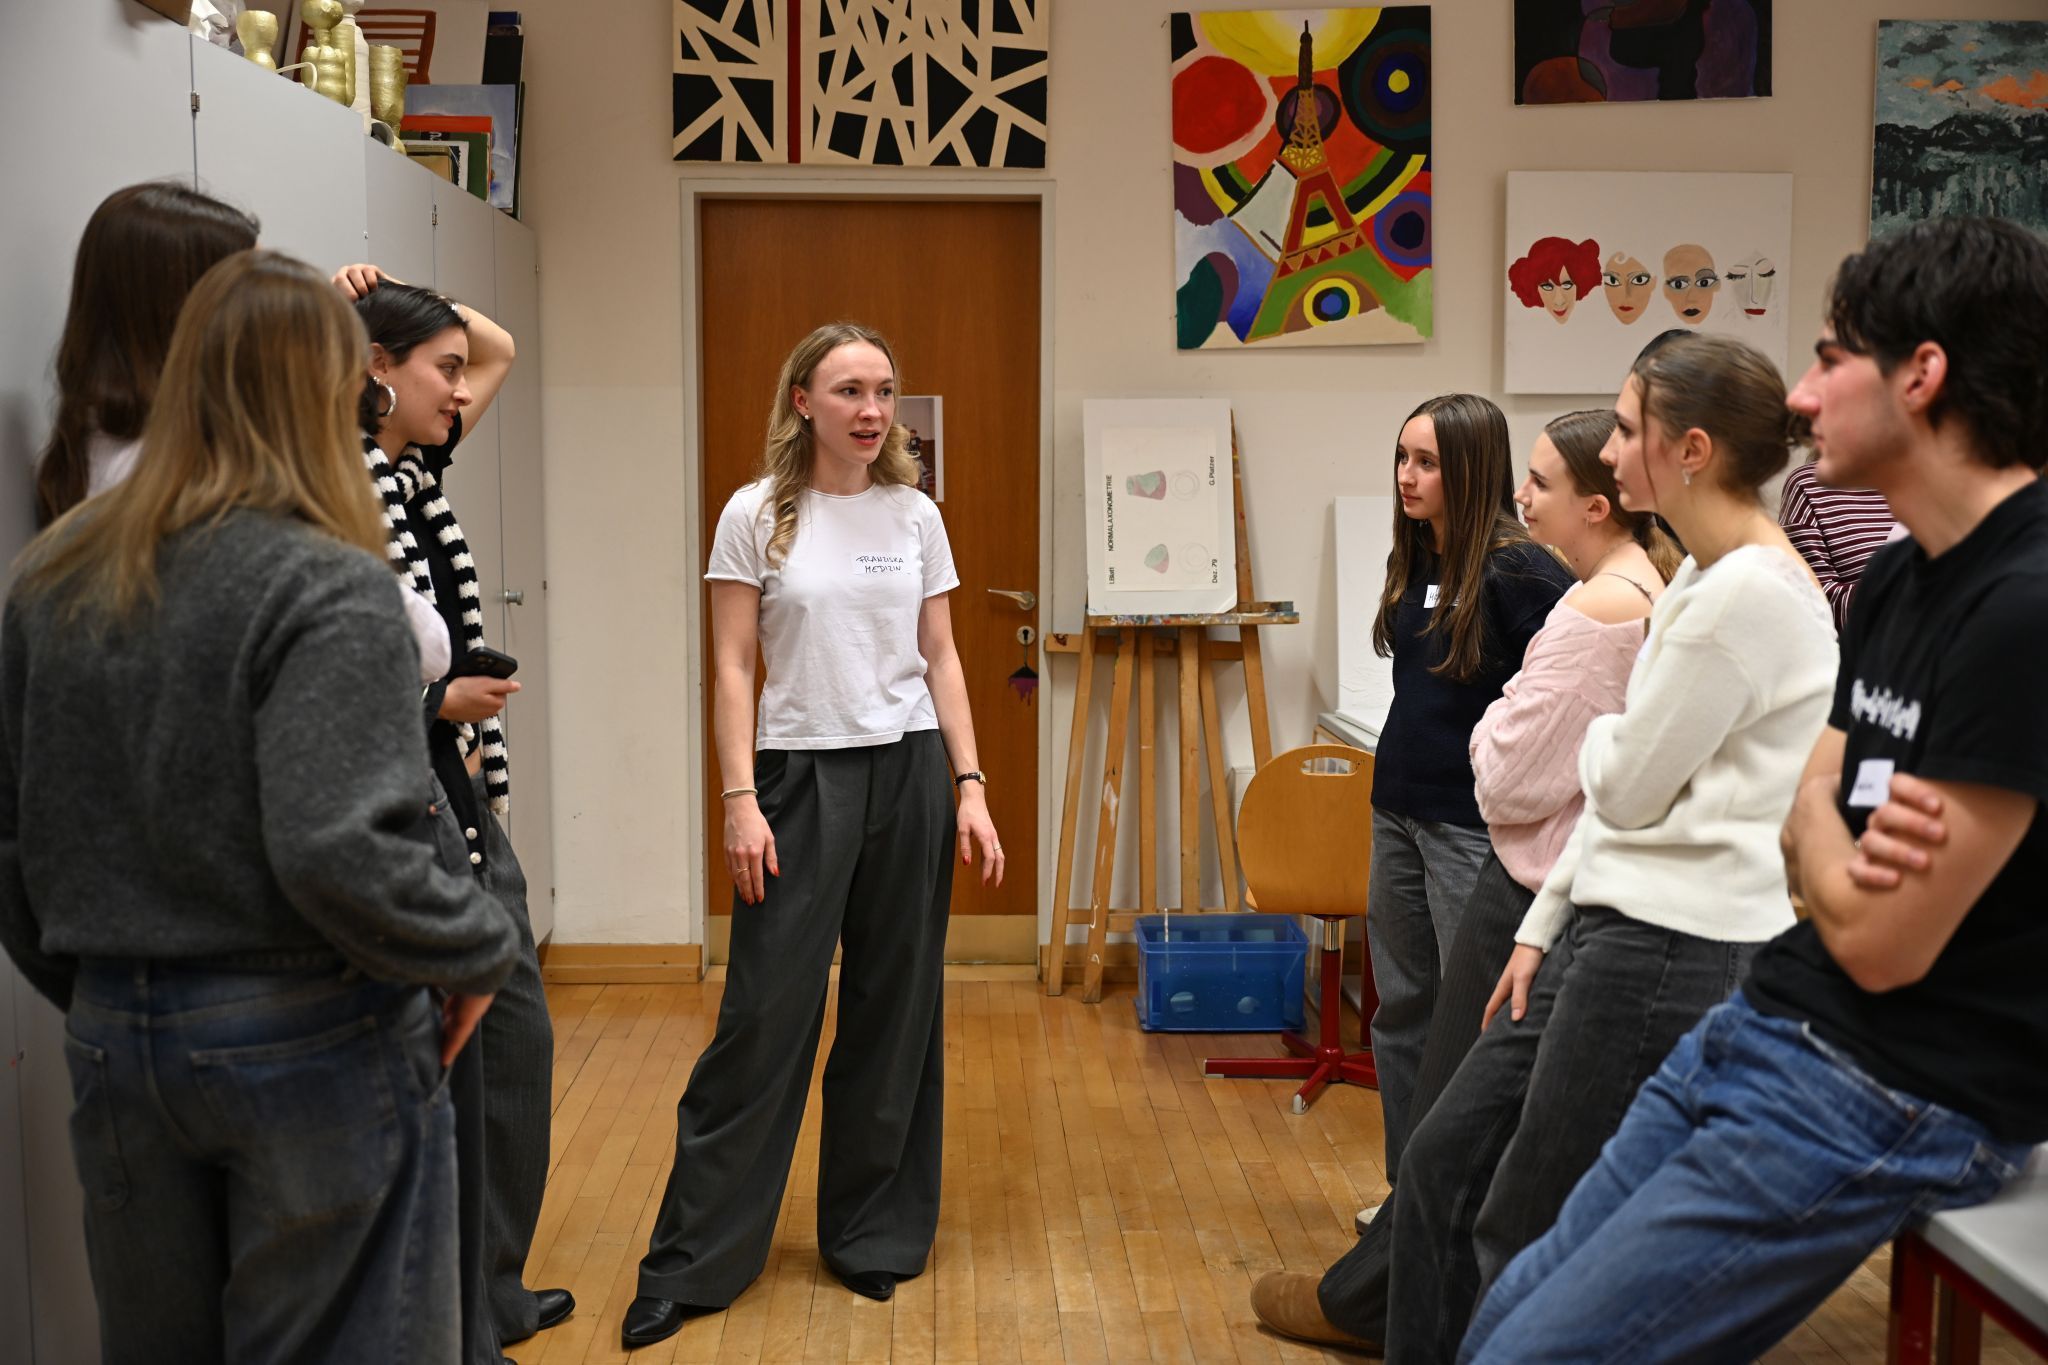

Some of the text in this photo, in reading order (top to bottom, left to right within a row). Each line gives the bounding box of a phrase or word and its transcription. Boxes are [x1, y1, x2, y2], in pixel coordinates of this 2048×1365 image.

[1105, 474, 1115, 552] NORMALAXONOMETRIE
[855, 555, 904, 563] FRANZISKA
[865, 565, 901, 574] MEDIZIN
